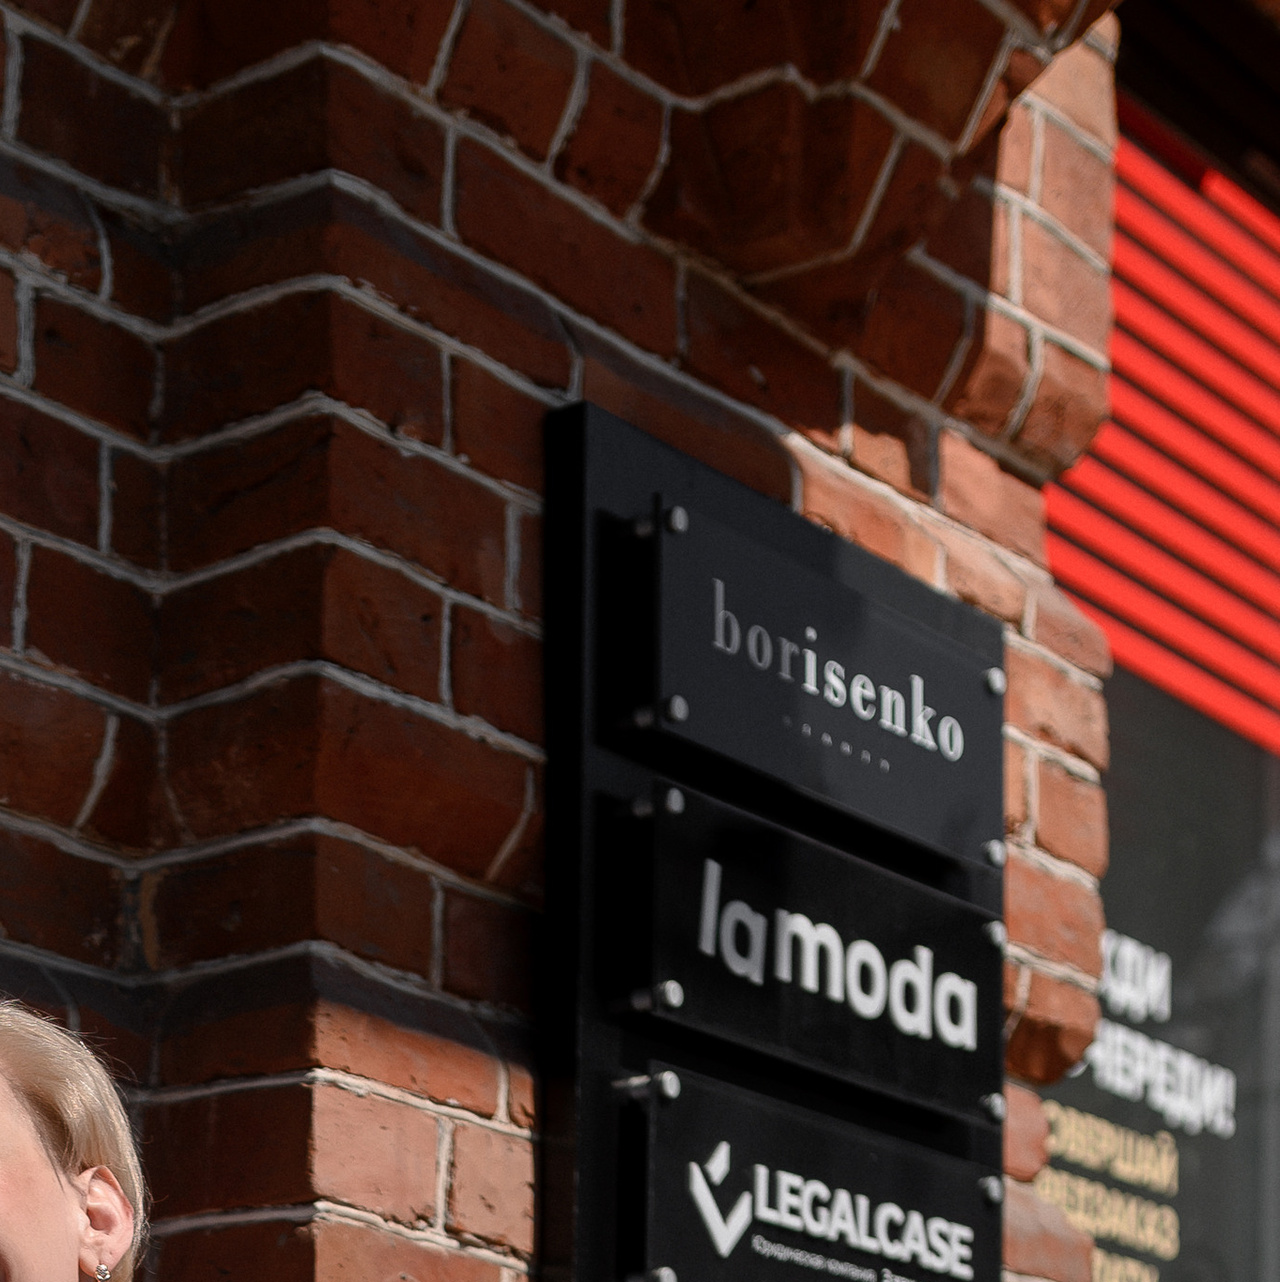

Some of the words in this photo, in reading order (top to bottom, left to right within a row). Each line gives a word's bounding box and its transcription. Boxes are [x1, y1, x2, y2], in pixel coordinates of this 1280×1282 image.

[712, 578, 965, 762] borisenko
[698, 858, 978, 1051] lamoda
[753, 1163, 974, 1281] LEGALCASE
